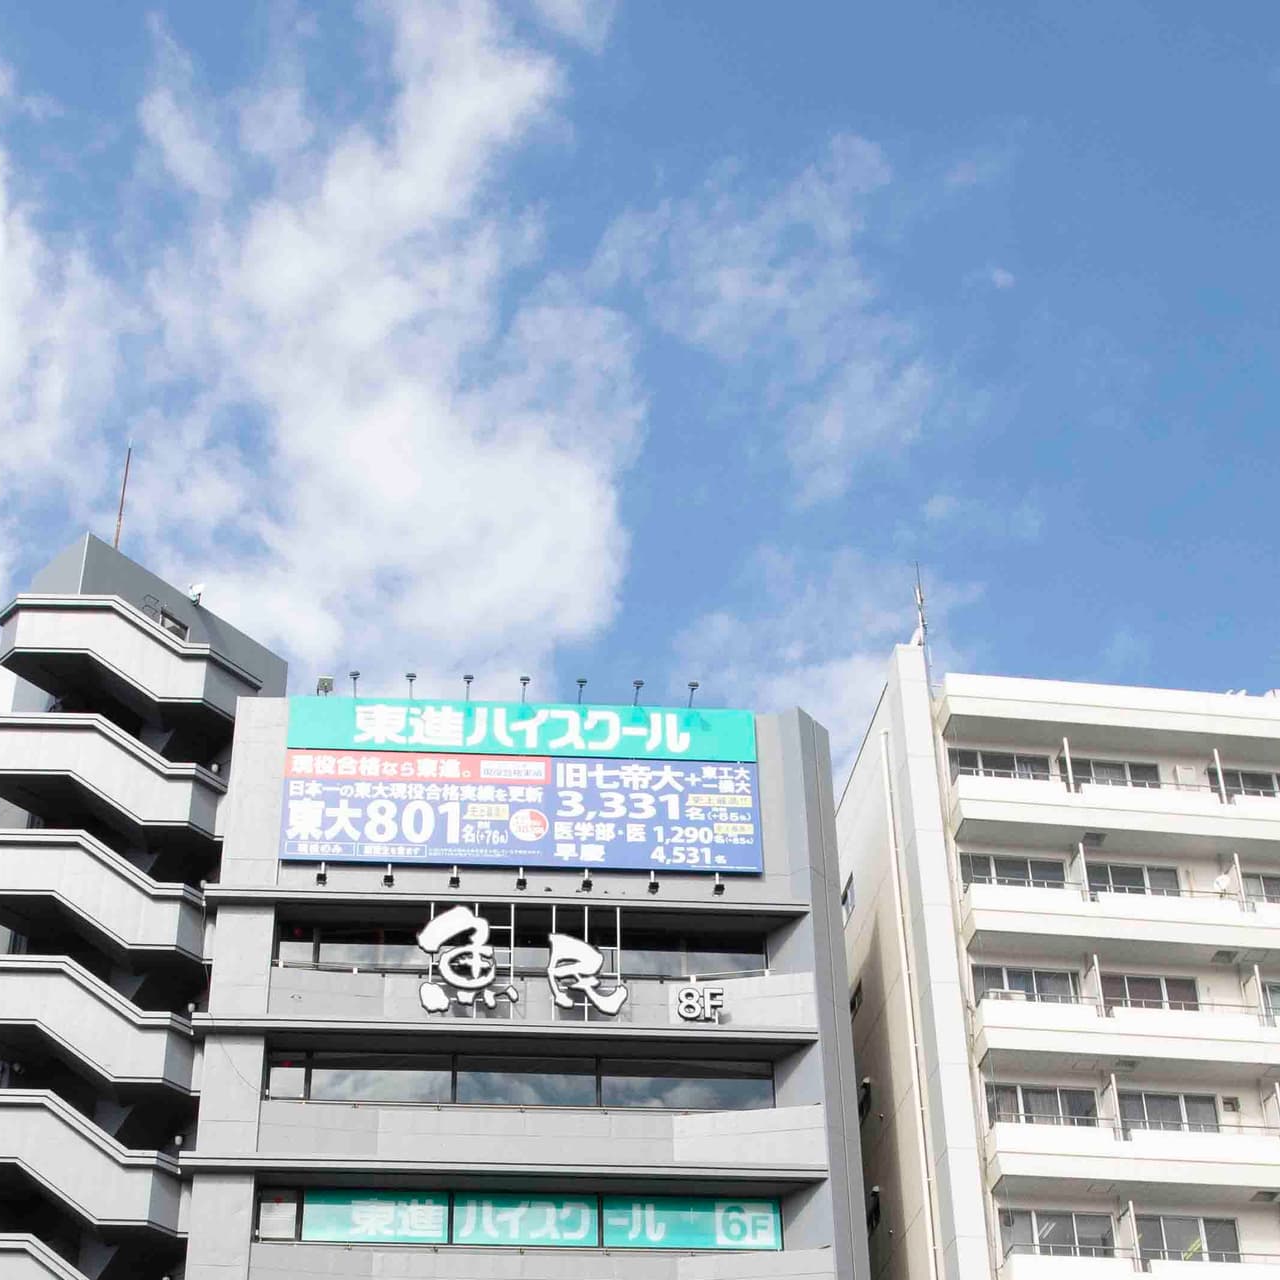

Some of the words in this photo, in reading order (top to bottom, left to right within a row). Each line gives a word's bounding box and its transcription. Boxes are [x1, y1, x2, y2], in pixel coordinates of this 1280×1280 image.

[354, 705, 690, 753] 東進ハイスクール
[416, 904, 629, 1016] 魚民
[677, 987, 724, 1022] 8F
[350, 1198, 666, 1244] 東進ハイスクール
[721, 1204, 773, 1246] 6F
